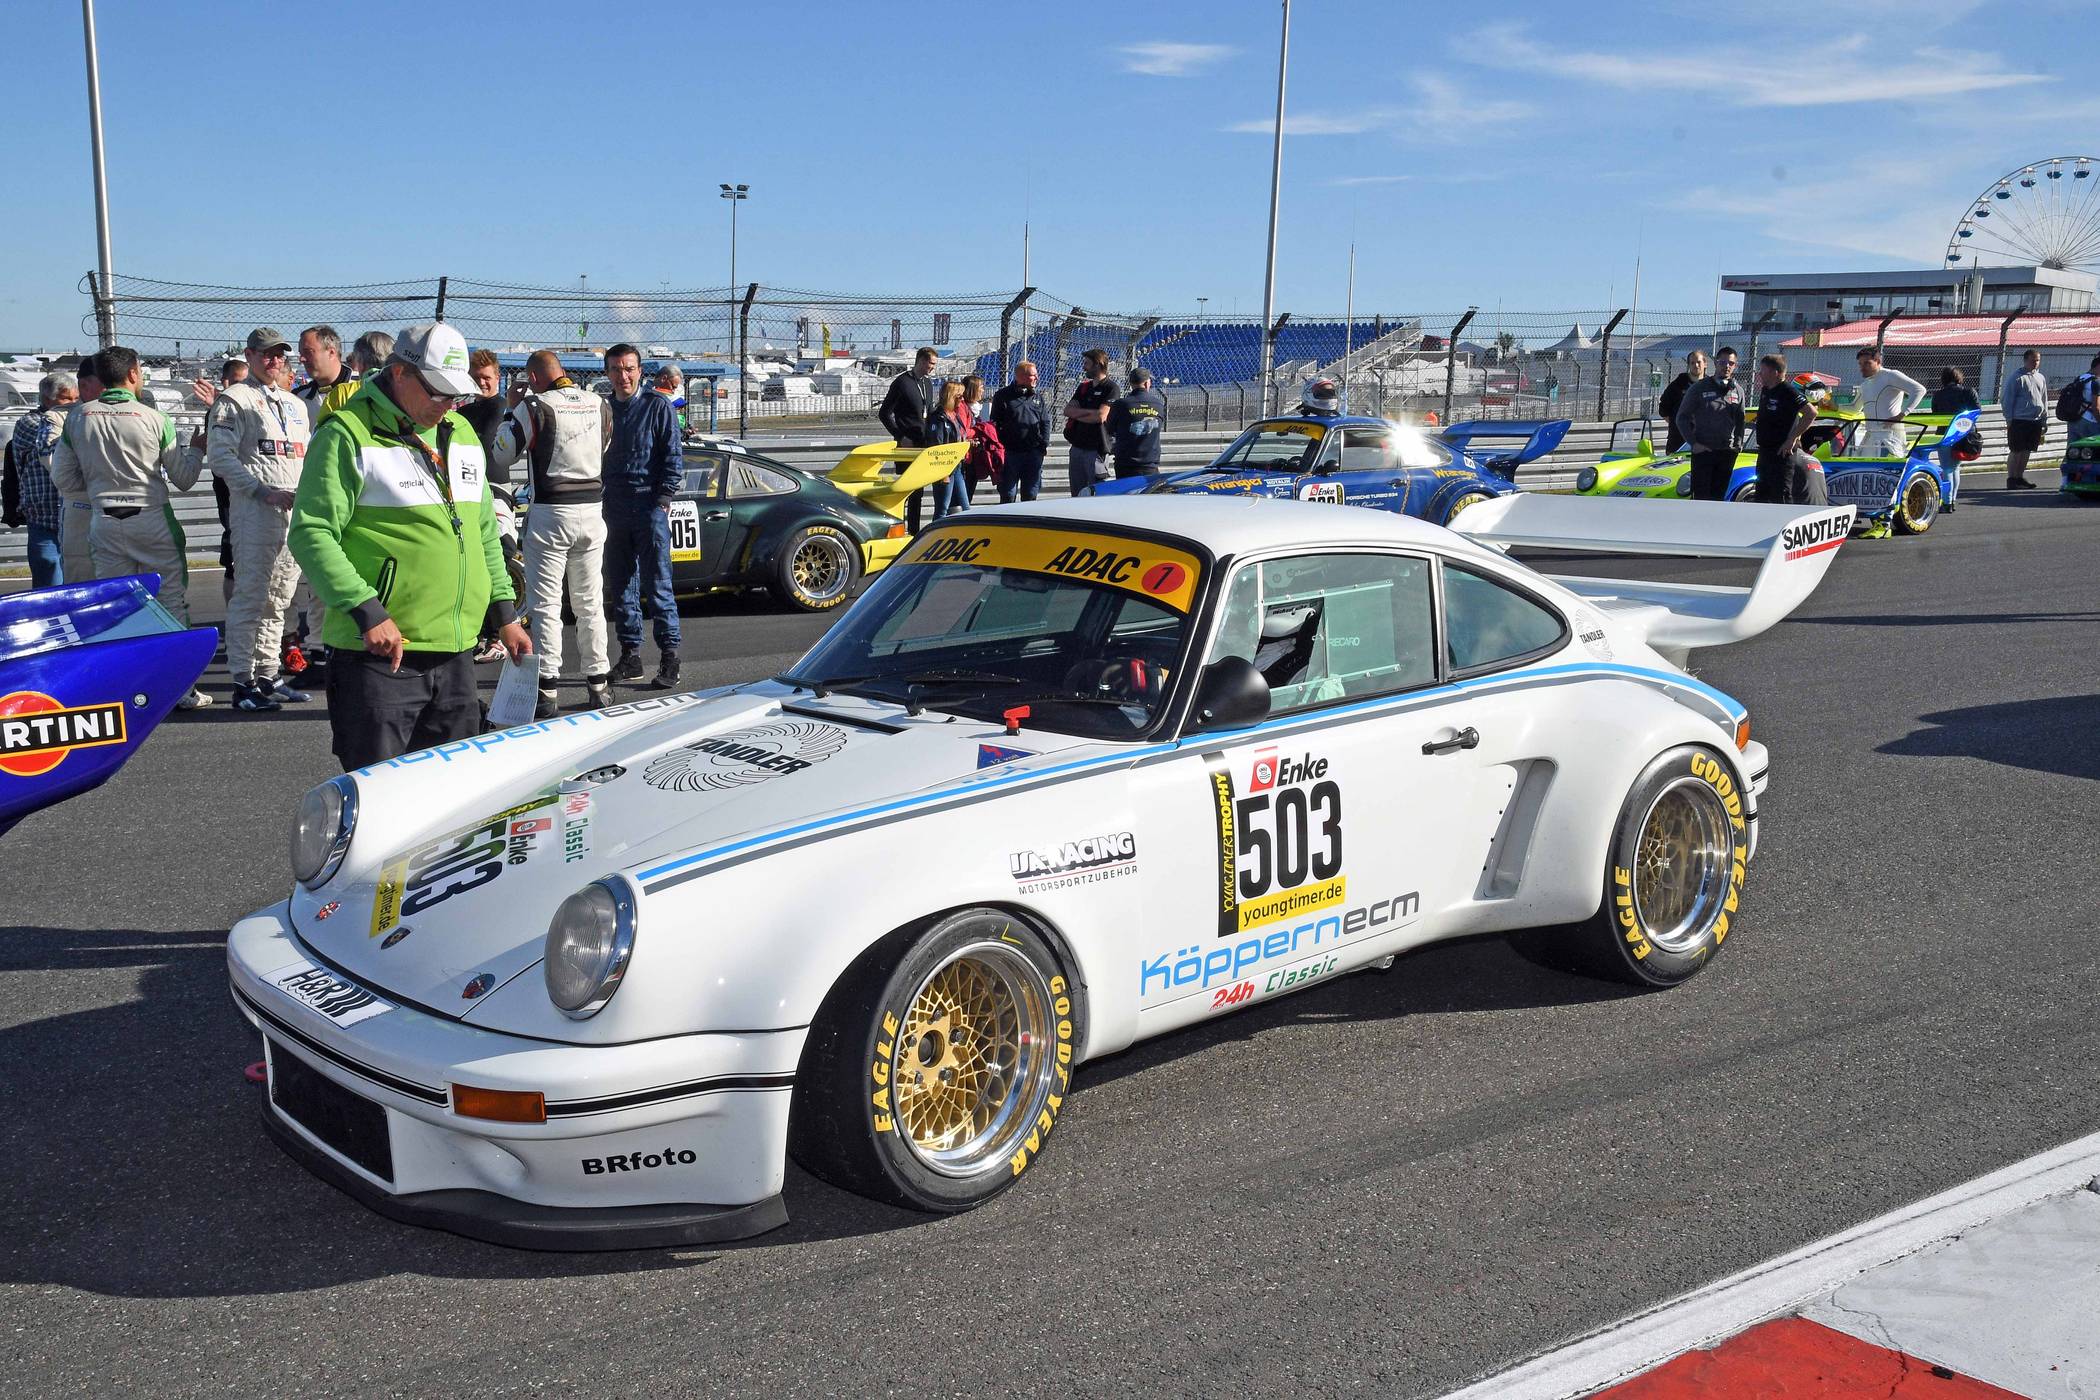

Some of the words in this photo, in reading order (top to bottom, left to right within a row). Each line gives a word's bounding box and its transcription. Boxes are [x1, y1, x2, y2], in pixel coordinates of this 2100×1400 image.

[1129, 407, 1159, 416] Wrangler
[399, 479, 425, 489] Official
[1206, 477, 1264, 491] Wrangler
[1319, 487, 1335, 496] Enke
[1828, 474, 1858, 496] TWIN
[669, 508, 692, 518] Enke
[671, 518, 697, 549] 05
[807, 526, 837, 536] EAGLE
[1782, 514, 1851, 551] SANDTLER
[916, 538, 991, 562] ADAC
[1044, 546, 1141, 583] ADAC
[1152, 566, 1175, 590] 1
[1328, 636, 1360, 647] RECARO
[1579, 629, 1606, 644] TANDLER
[0, 710, 115, 750] RTINI
[683, 737, 813, 775] TANDLER
[1277, 752, 1328, 787] Enke
[507, 832, 538, 866] Enke
[565, 817, 591, 864] Classic
[1236, 780, 1342, 900] 503
[1691, 752, 1748, 945] GOODYEAR
[401, 818, 508, 917] 503
[1018, 865, 1139, 895] MOTORSPORTZUBEHÖR
[1244, 883, 1342, 927] youngtimer.de
[1615, 866, 1652, 960] EAGLE
[1211, 981, 1255, 1008] 24h
[1265, 956, 1338, 993] Classic
[872, 1010, 899, 1132] EAGLE
[1009, 975, 1073, 1175] GOODYEAR
[581, 1147, 697, 1175] BRfoto
